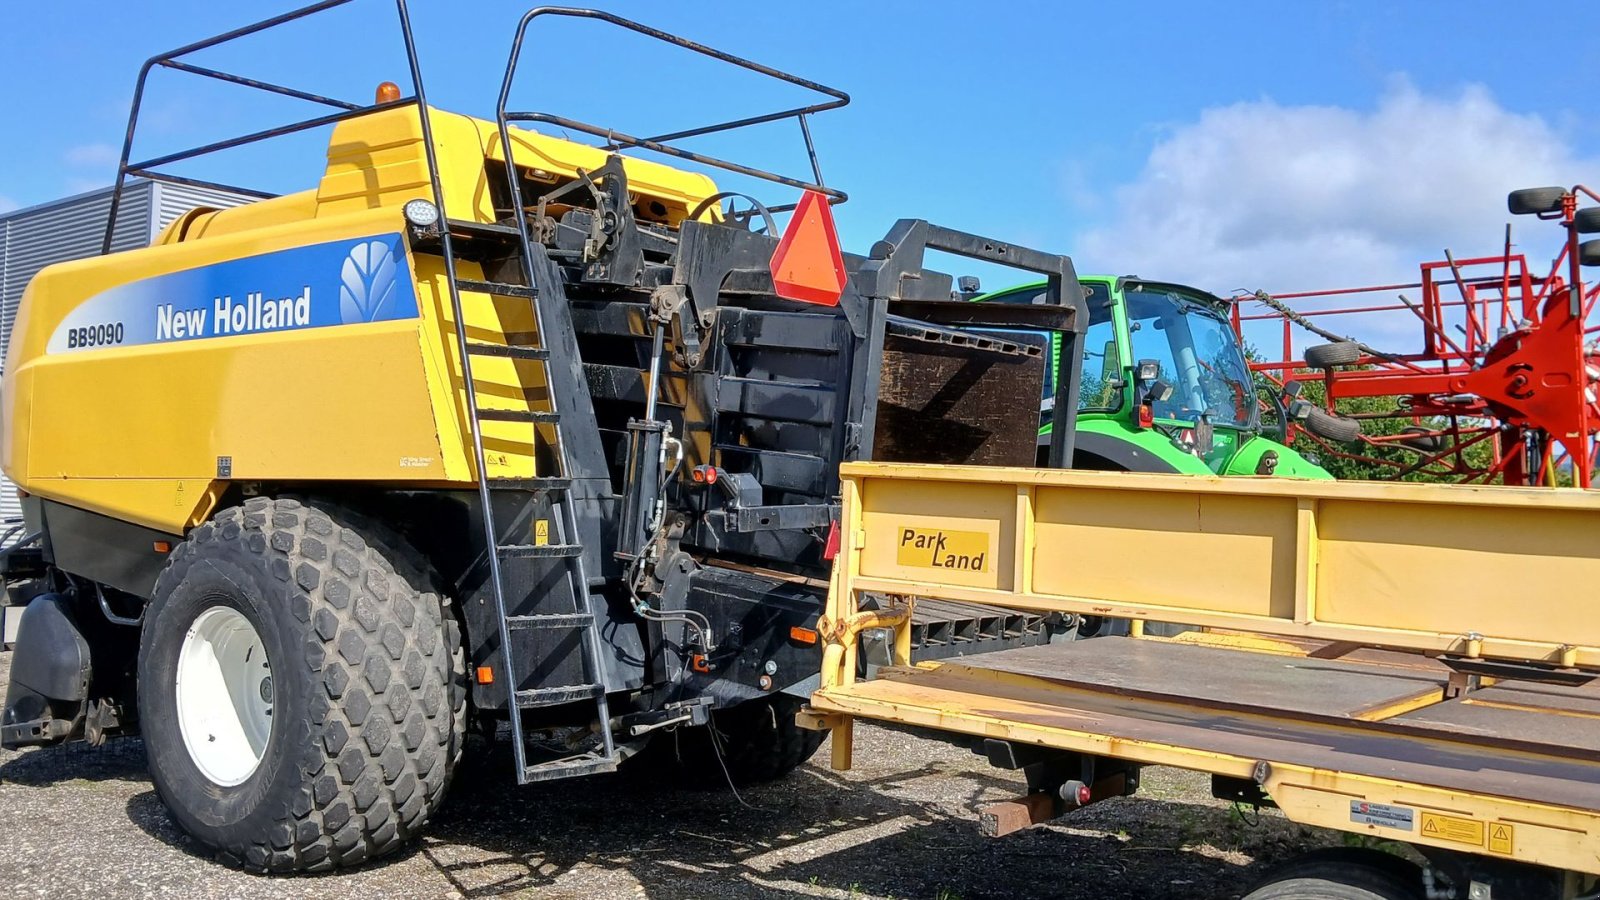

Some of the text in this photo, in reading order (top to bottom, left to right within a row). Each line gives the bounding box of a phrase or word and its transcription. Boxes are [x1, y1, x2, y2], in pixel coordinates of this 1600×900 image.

[156, 286, 311, 340] New Holland
[68, 322, 124, 348] BB9090
[901, 529, 947, 549] Park
[932, 547, 984, 570] Land
